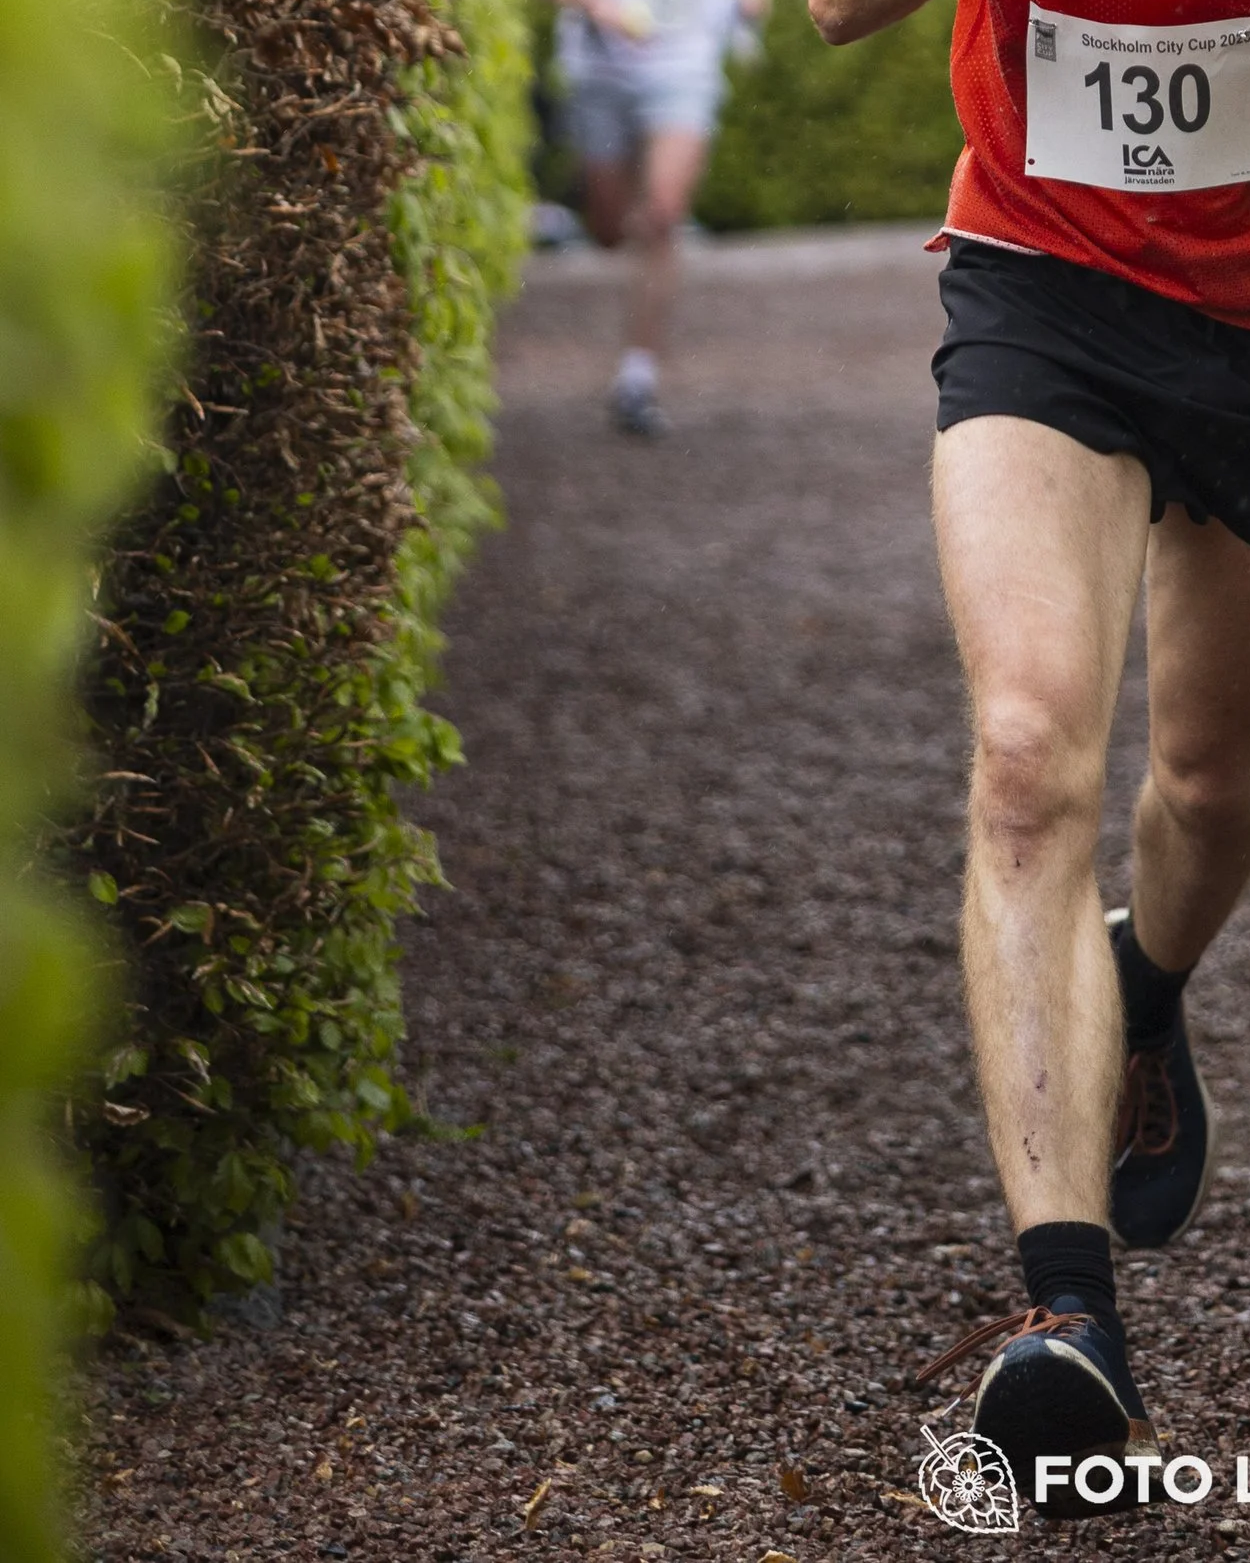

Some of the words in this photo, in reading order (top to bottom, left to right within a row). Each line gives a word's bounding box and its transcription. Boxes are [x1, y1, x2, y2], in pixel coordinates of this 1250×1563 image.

[1081, 33, 1152, 54] Stockholm
[1156, 39, 1184, 56] City
[1188, 37, 1216, 53] Cup
[1084, 60, 1211, 135] 130
[1122, 143, 1174, 167] ICA
[1148, 167, 1175, 176] nära
